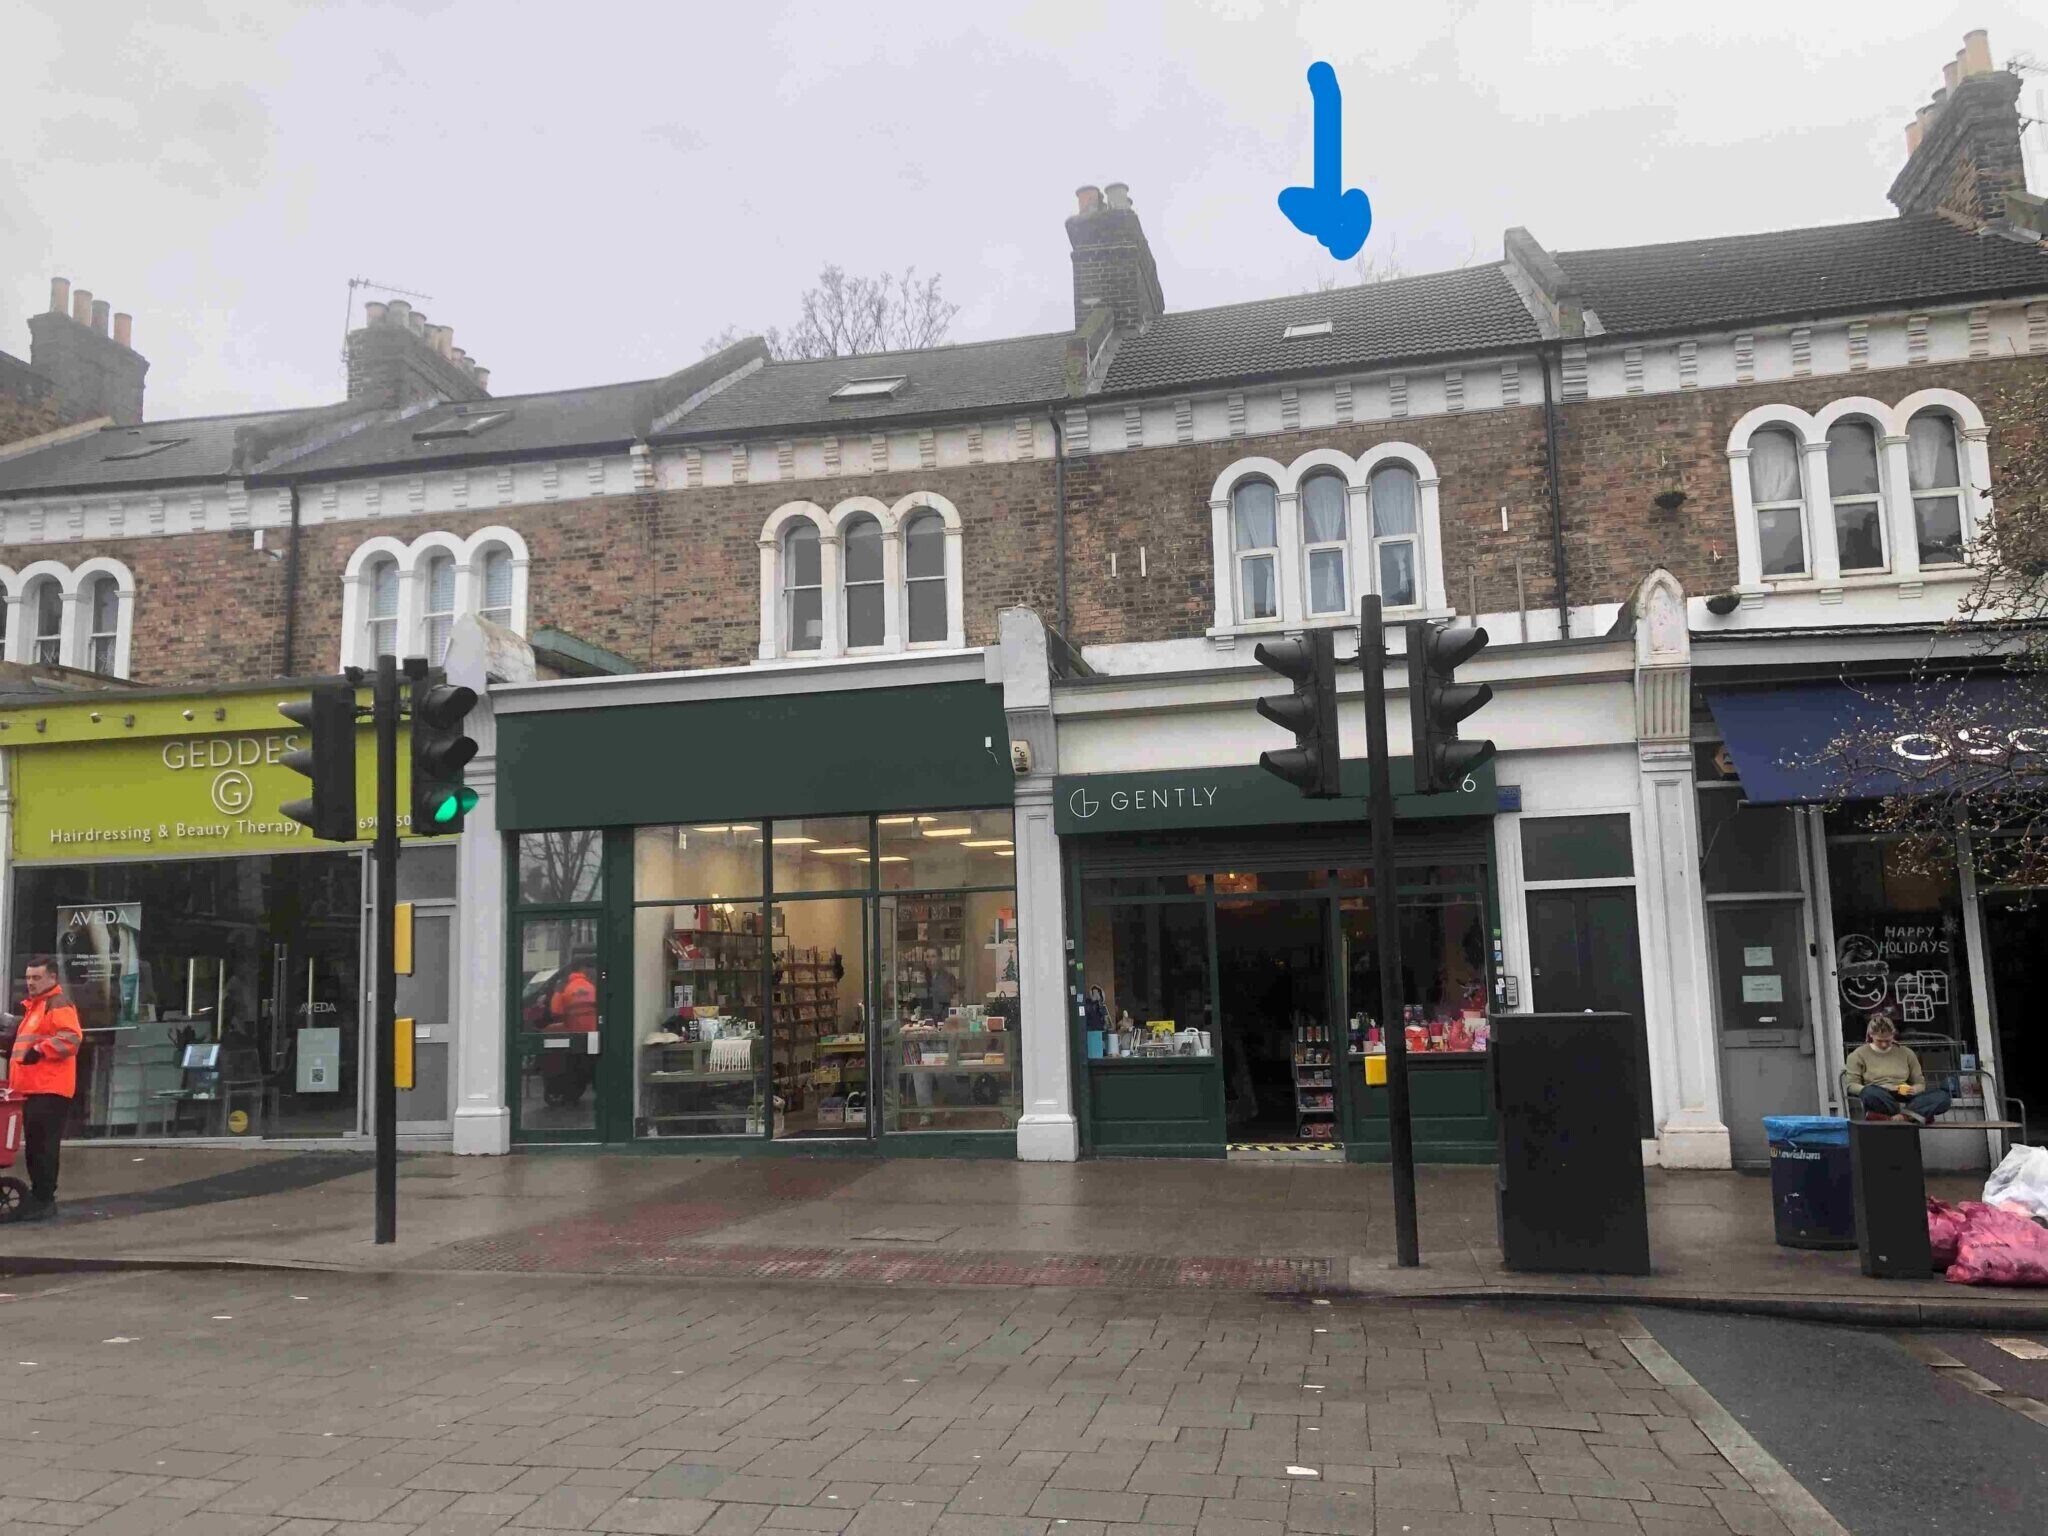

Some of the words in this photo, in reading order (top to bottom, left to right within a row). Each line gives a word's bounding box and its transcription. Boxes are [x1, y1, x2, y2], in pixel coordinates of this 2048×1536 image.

[219, 777, 243, 806] G
[1110, 786, 1218, 811] GENTLY
[50, 828, 151, 843] Hairdressing
[158, 825, 168, 838] &
[176, 819, 230, 839] Beauty
[236, 818, 301, 836] Therapy
[69, 909, 131, 926] AVEDA
[1884, 926, 1935, 938] HAPPY
[1879, 940, 1950, 954] HOLIDAYS
[299, 1002, 337, 1014] AVEDA
